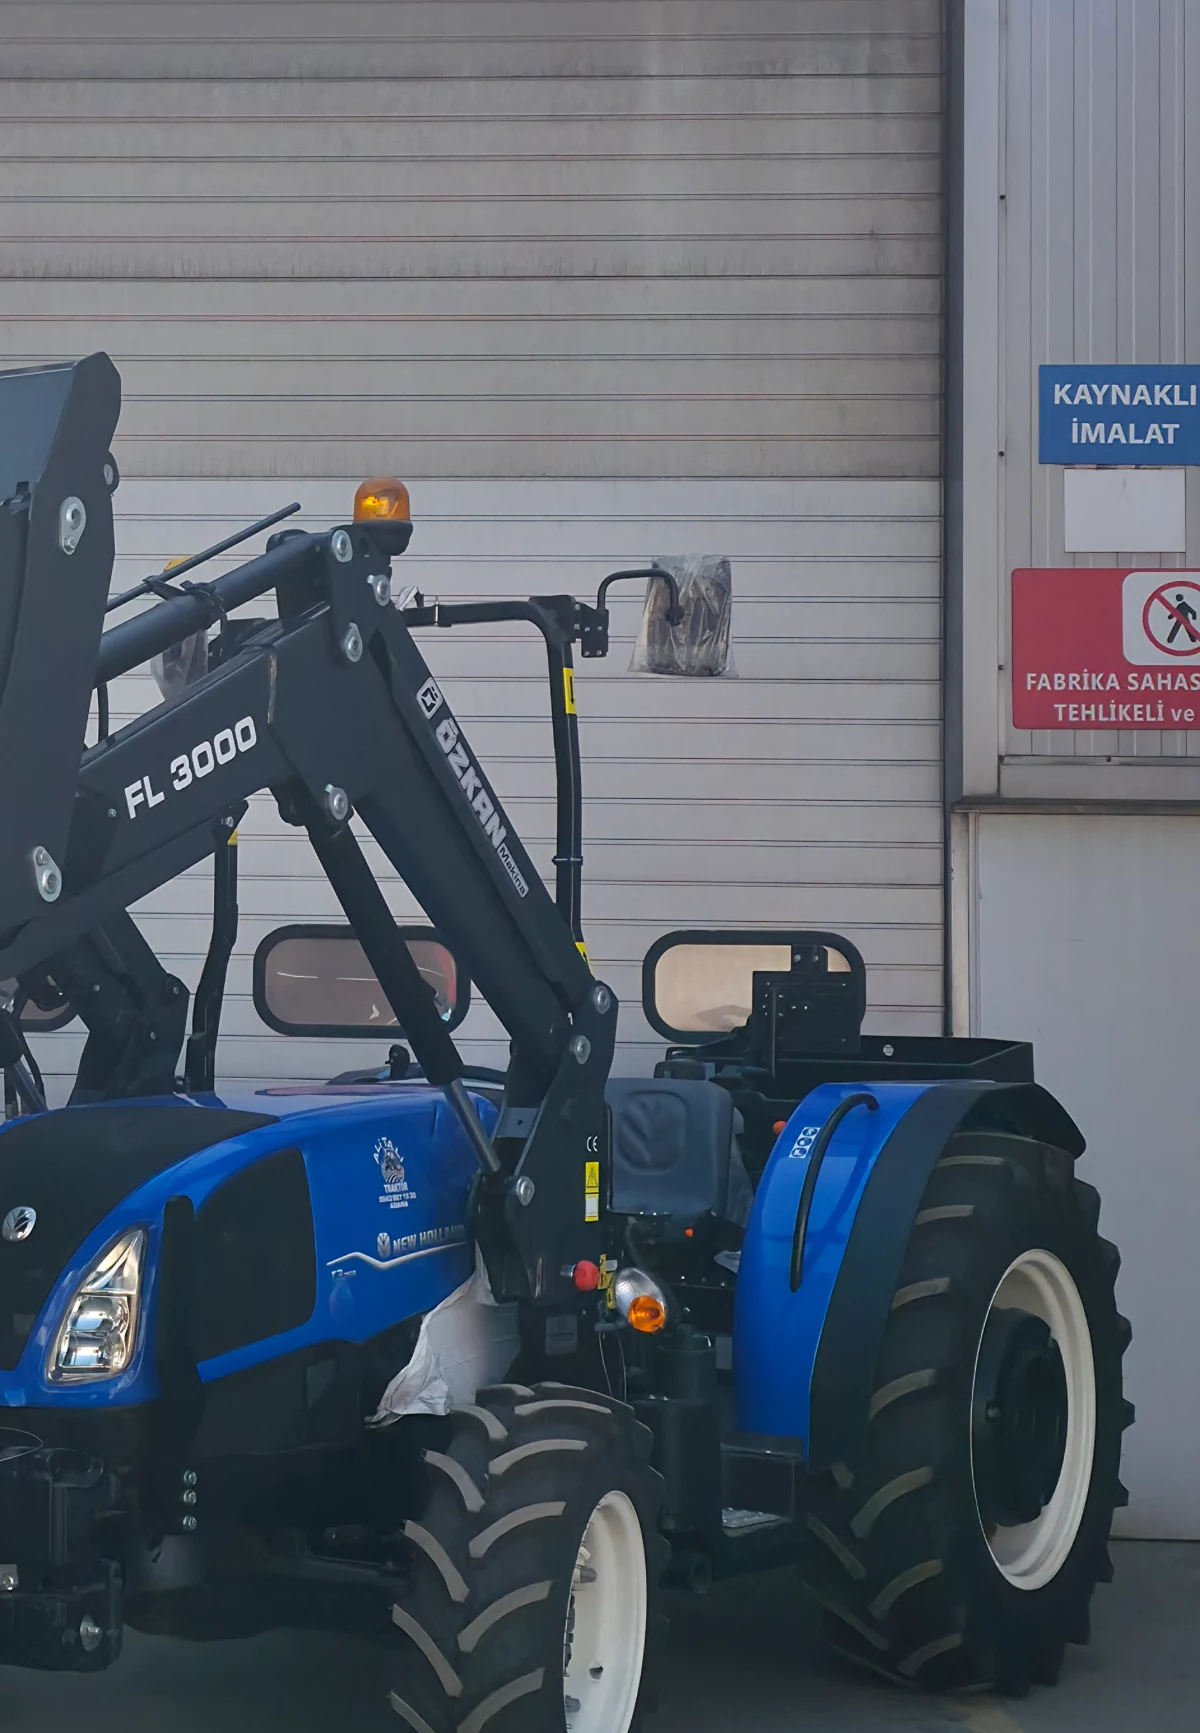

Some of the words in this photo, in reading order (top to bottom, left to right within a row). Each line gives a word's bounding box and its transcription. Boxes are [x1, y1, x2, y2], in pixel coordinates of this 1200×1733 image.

[1054, 383, 1197, 406] KAYNAKLI
[1071, 417, 1180, 445] İMALAT
[1025, 669, 1121, 691] FABRİKA
[1054, 700, 1165, 722] TEHLİKELİ
[1171, 708, 1195, 722] ve
[124, 775, 165, 819] FL
[170, 715, 257, 791] 3000
[435, 717, 507, 850] ÖZKAN
[499, 846, 526, 895] Makina
[393, 1234, 417, 1253] NEW
